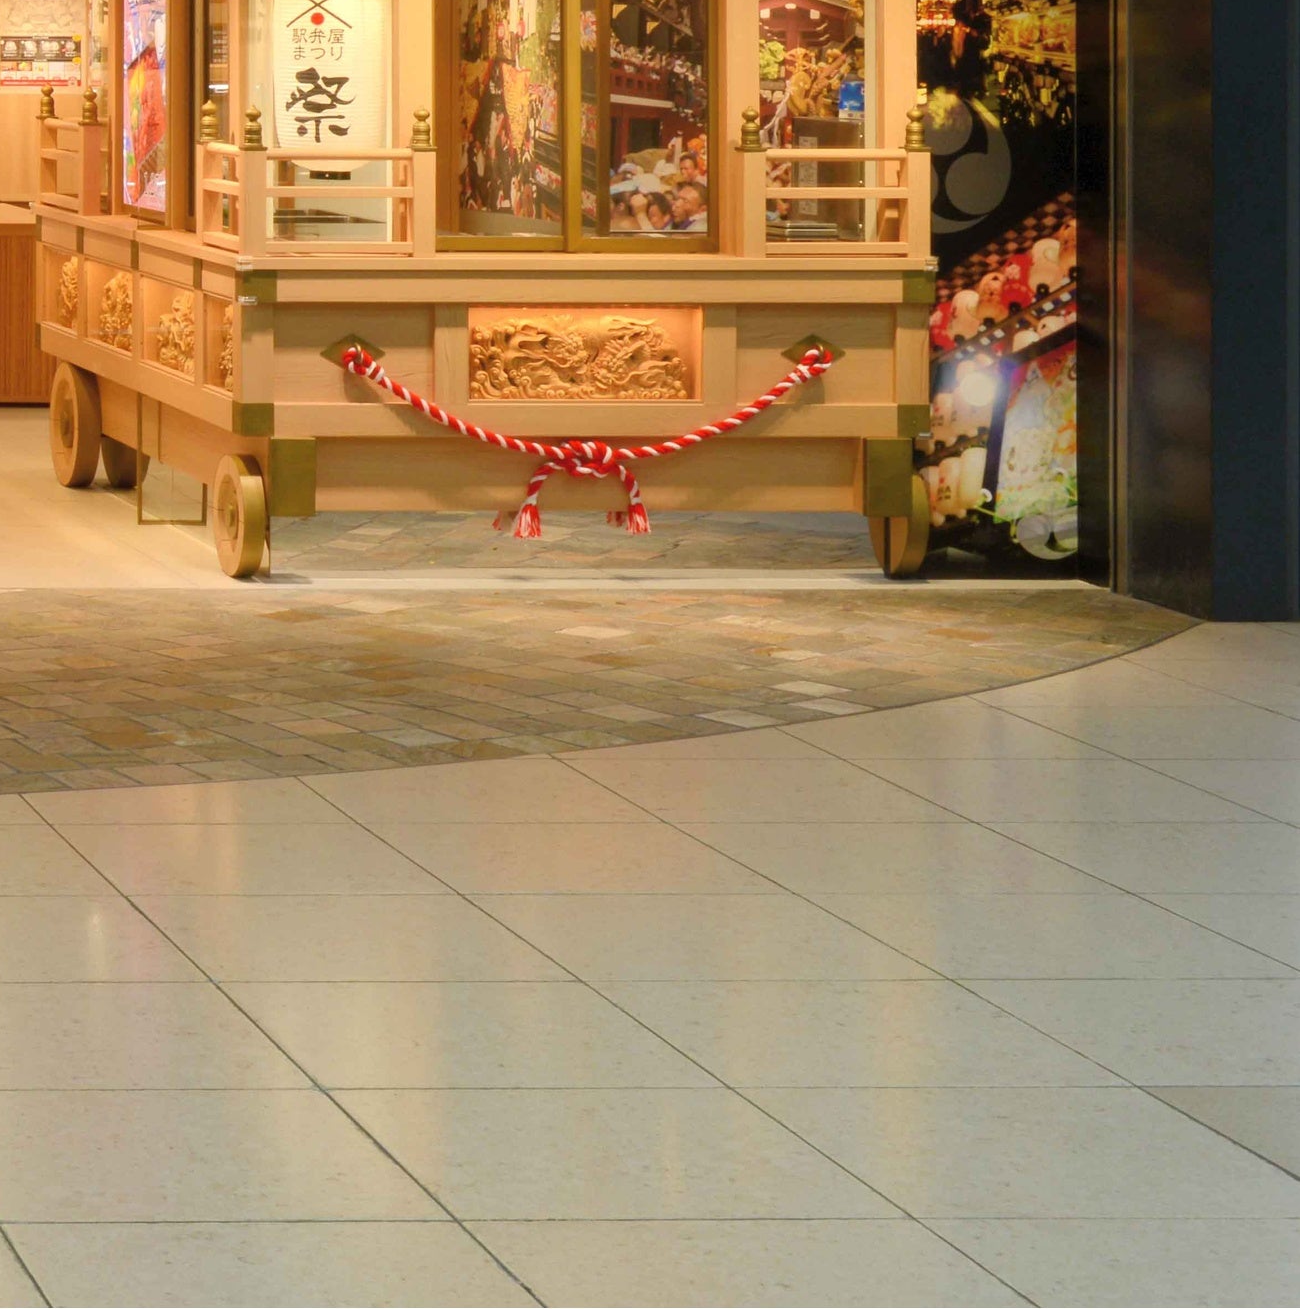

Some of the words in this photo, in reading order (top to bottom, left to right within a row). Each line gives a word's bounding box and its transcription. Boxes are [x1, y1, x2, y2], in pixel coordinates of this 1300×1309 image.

[292, 28, 345, 45] 駅弁屋
[292, 45, 345, 61] まつり
[285, 67, 357, 143] 祭
